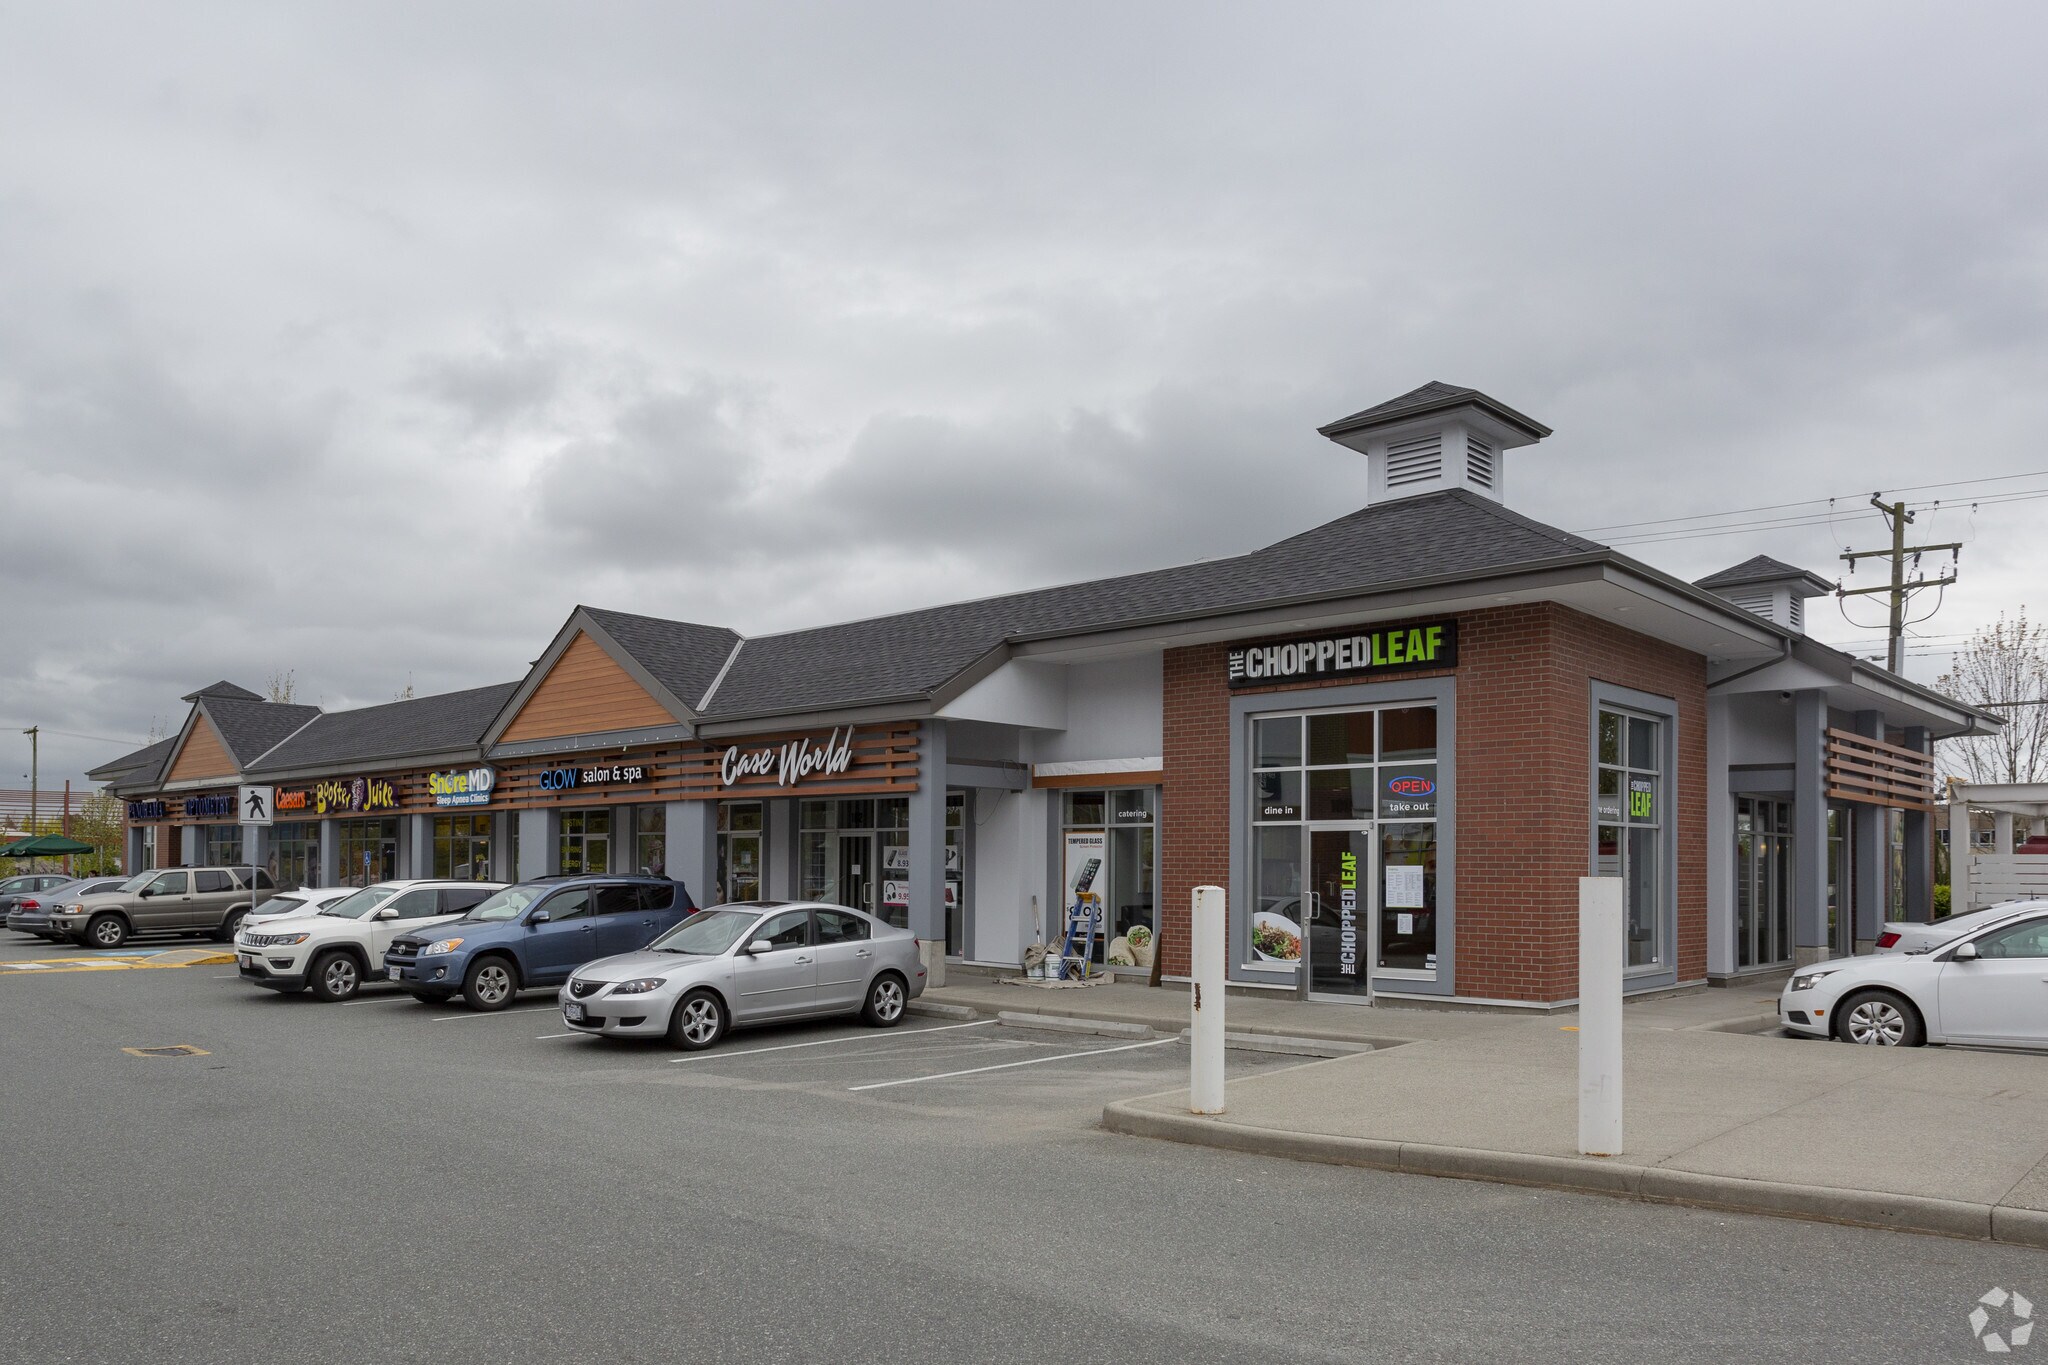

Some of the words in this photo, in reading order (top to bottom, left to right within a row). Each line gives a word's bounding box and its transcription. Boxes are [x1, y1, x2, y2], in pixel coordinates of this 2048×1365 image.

[1229, 651, 1244, 680] THE
[721, 746, 775, 786] Case
[778, 724, 854, 787] World
[539, 768, 577, 790] GLOW
[583, 766, 610, 783] salon
[612, 765, 621, 781] &
[623, 766, 642, 783] spa
[1391, 780, 1430, 792] OPEN
[1634, 780, 1651, 792] CHOPPED
[316, 781, 351, 814] Booster
[363, 778, 394, 811] Juice
[436, 796, 451, 805] Sleep
[451, 795, 469, 805] Apnea
[470, 793, 488, 803] Clinics
[1390, 803, 1410, 811] take
[1413, 803, 1429, 811] out
[1631, 791, 1652, 817] LEAF
[1118, 809, 1147, 818] catering
[1264, 806, 1283, 815] dine
[1285, 806, 1293, 814] in
[1603, 806, 1619, 816] ordering
[1341, 964, 1356, 974] THE
